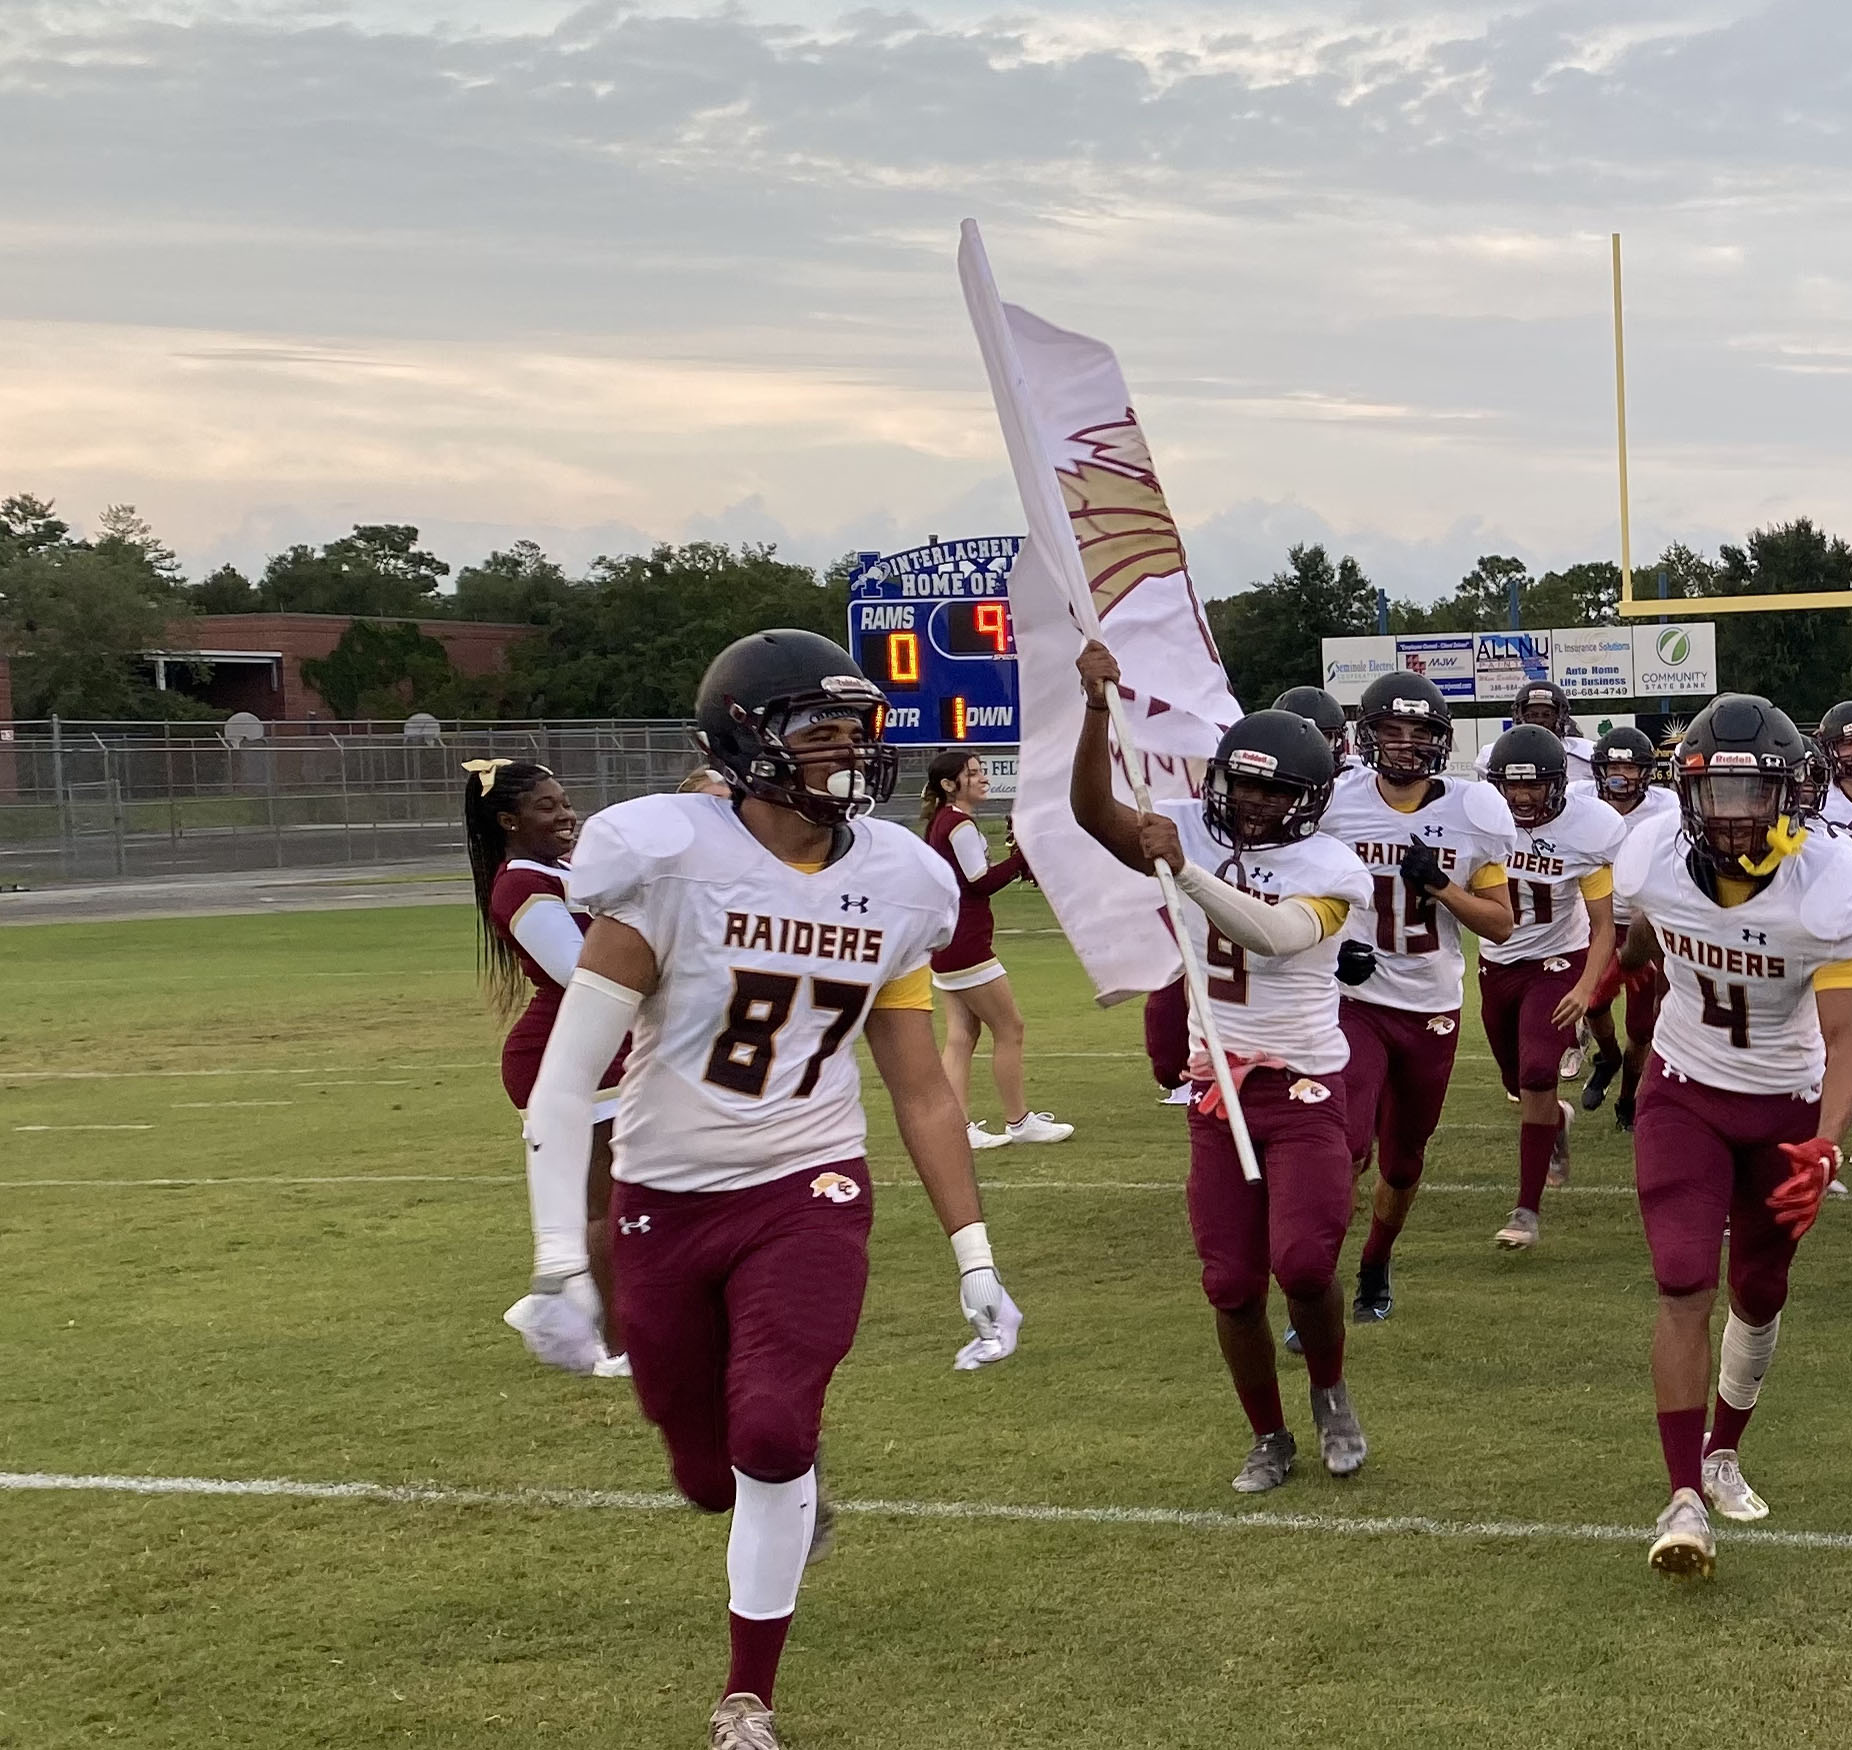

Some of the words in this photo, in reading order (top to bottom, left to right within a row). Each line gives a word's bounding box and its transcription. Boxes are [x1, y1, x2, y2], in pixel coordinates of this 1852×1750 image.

[889, 538, 1013, 577] INTERLACHEN
[901, 572, 965, 597] HOME
[970, 572, 996, 595] OF
[861, 606, 916, 630] RAMS
[889, 632, 919, 682] 0
[1554, 644, 1563, 653] FL
[1564, 643, 1597, 653] Insurance
[1600, 642, 1631, 652] Solutions
[1335, 660, 1367, 672] Seminole
[1368, 659, 1395, 672] Electric
[1428, 657, 1458, 667] MJW
[1566, 667, 1588, 675] Auto
[1592, 666, 1619, 675] Home
[1560, 679, 1577, 687] Life
[1582, 677, 1627, 687] Business
[1642, 672, 1708, 683] COMMUNITY
[1563, 686, 1628, 697] 86-684-4749
[885, 707, 920, 728] QTR
[953, 696, 966, 740] 1
[966, 706, 1013, 727] DWN
[992, 760, 1018, 776] FEL
[1715, 754, 1753, 764] Riddell
[1355, 842, 1457, 871] RAIDS
[724, 911, 884, 965] RAIDERS
[1660, 926, 1786, 979] RAIDERS
[1694, 968, 1750, 1049] 4
[700, 965, 873, 1100] 87
